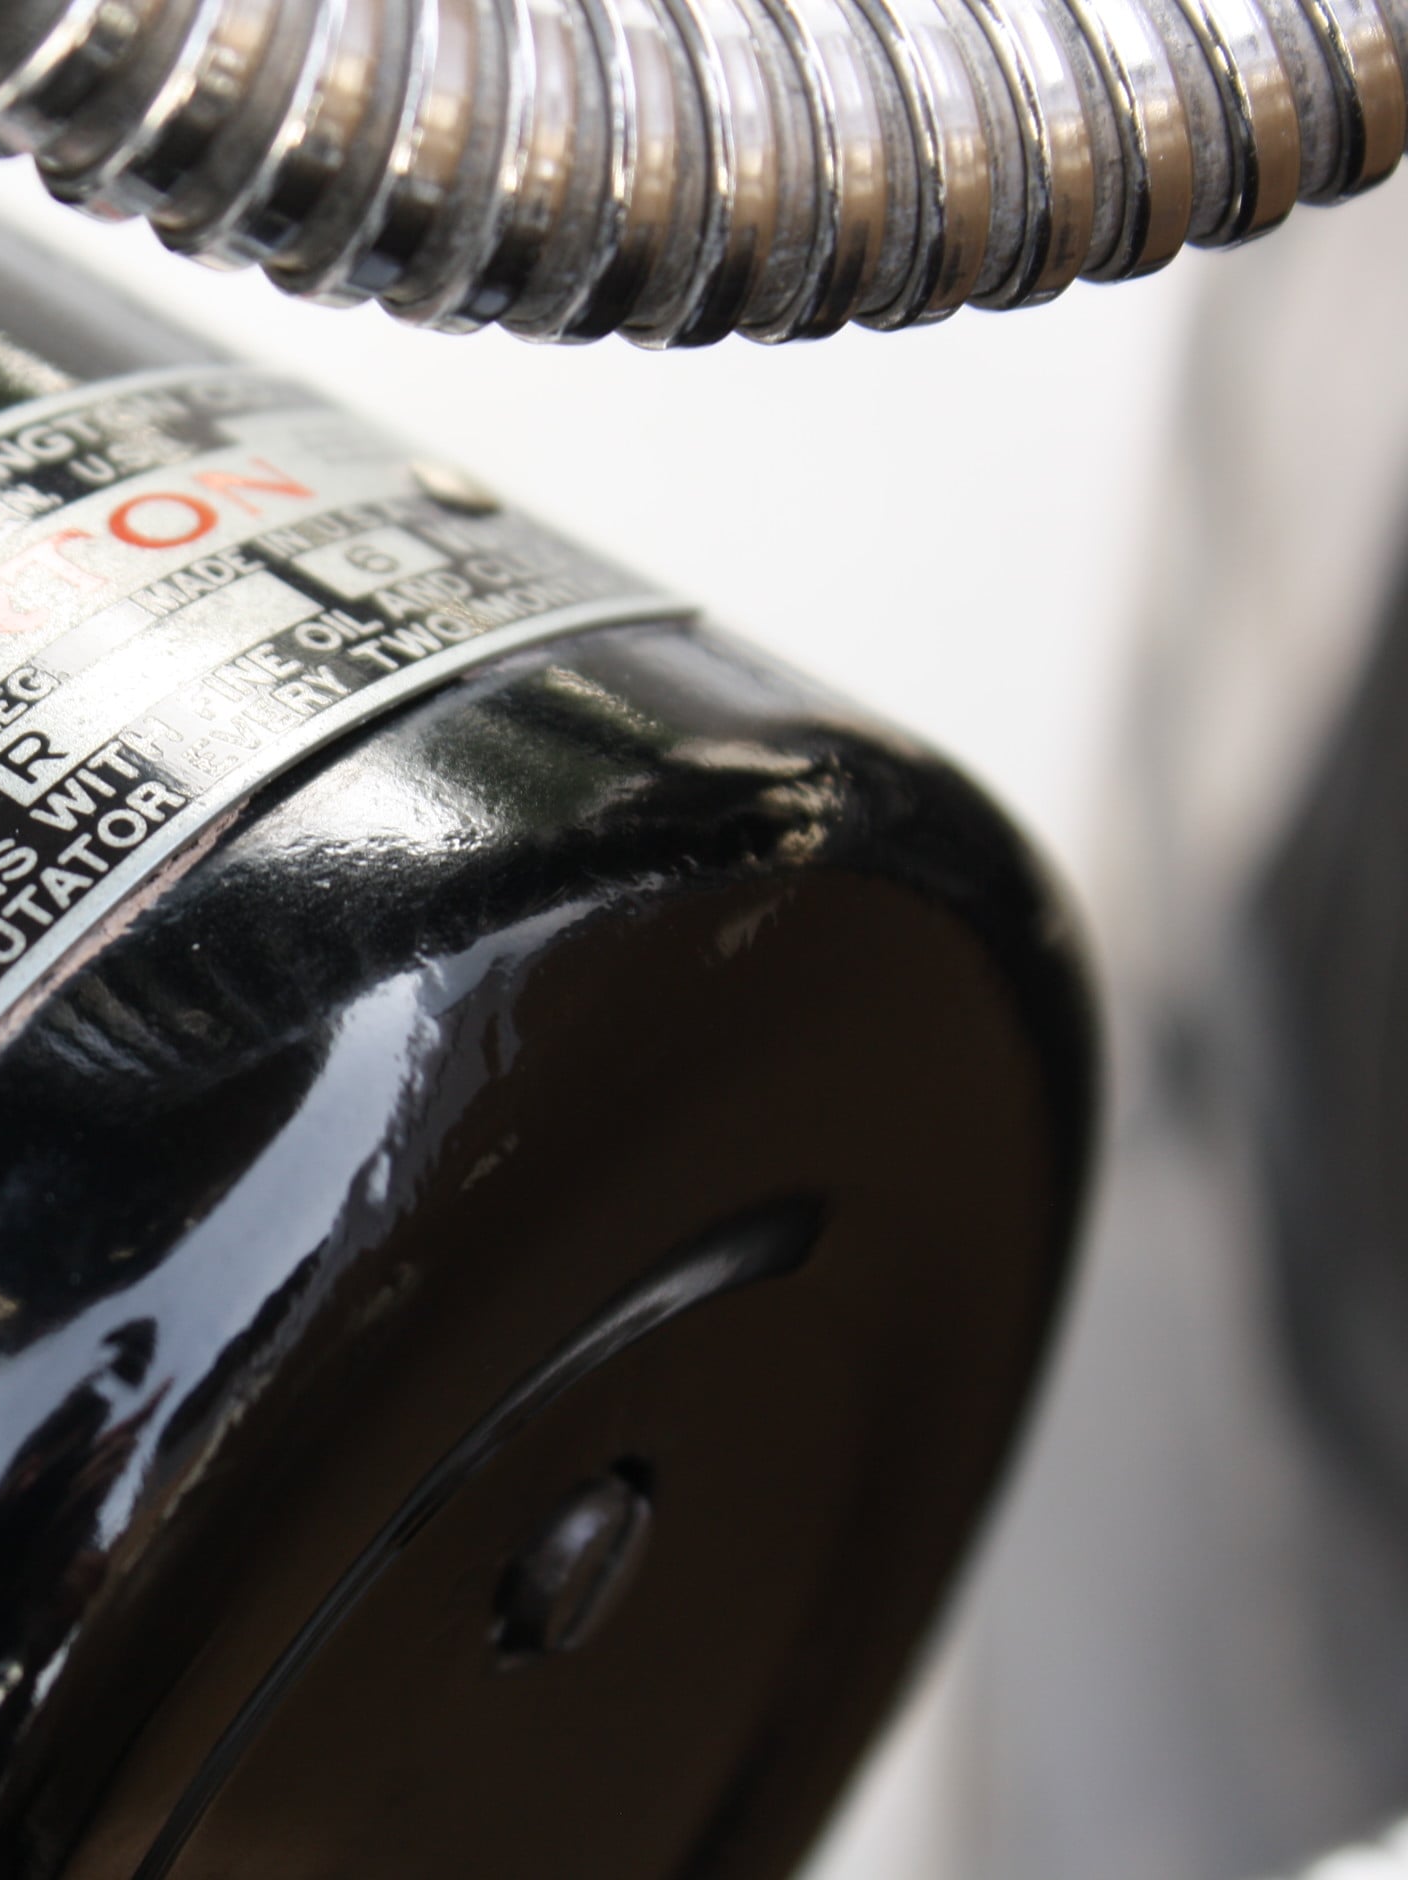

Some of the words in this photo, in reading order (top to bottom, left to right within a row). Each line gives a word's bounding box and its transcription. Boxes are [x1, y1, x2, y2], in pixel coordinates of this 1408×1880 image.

[130, 543, 266, 618] MADE
[344, 544, 402, 575] 6
[29, 717, 183, 831] WITH
[294, 609, 384, 651] OIL
[375, 571, 472, 619] AND
[182, 665, 351, 777] EVERY
[348, 613, 474, 670] TWO
